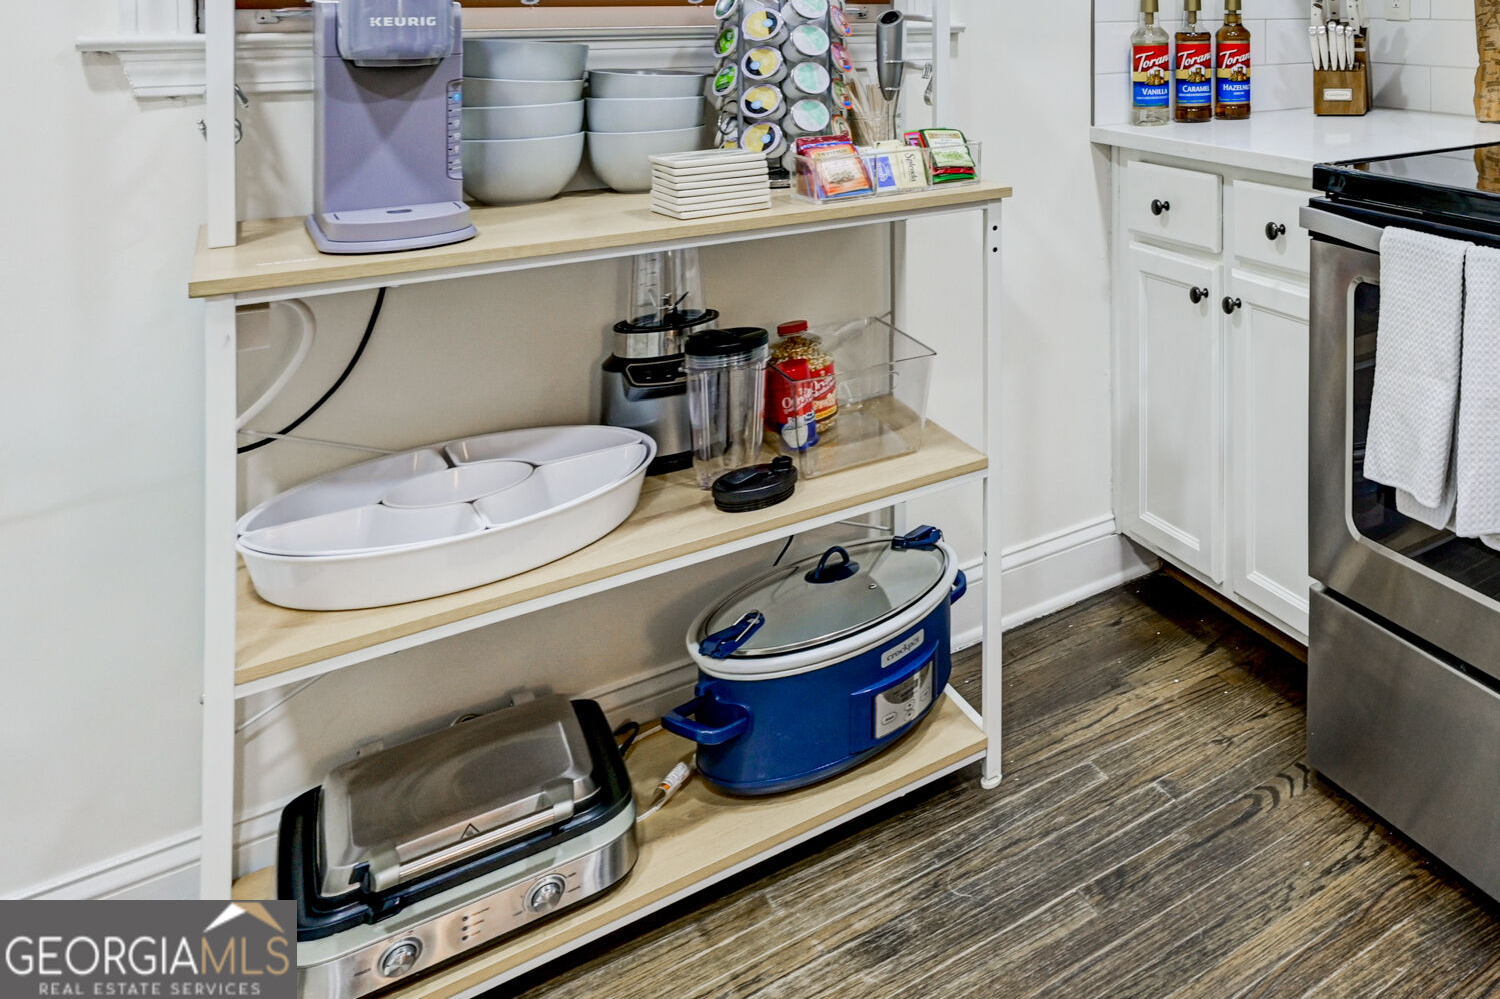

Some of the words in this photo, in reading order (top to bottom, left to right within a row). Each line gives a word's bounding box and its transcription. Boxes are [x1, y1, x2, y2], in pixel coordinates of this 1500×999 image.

[369, 16, 437, 27] KEURIG
[1135, 51, 1169, 73] Toran
[1177, 50, 1211, 70] Toran
[1219, 49, 1251, 70] Toran
